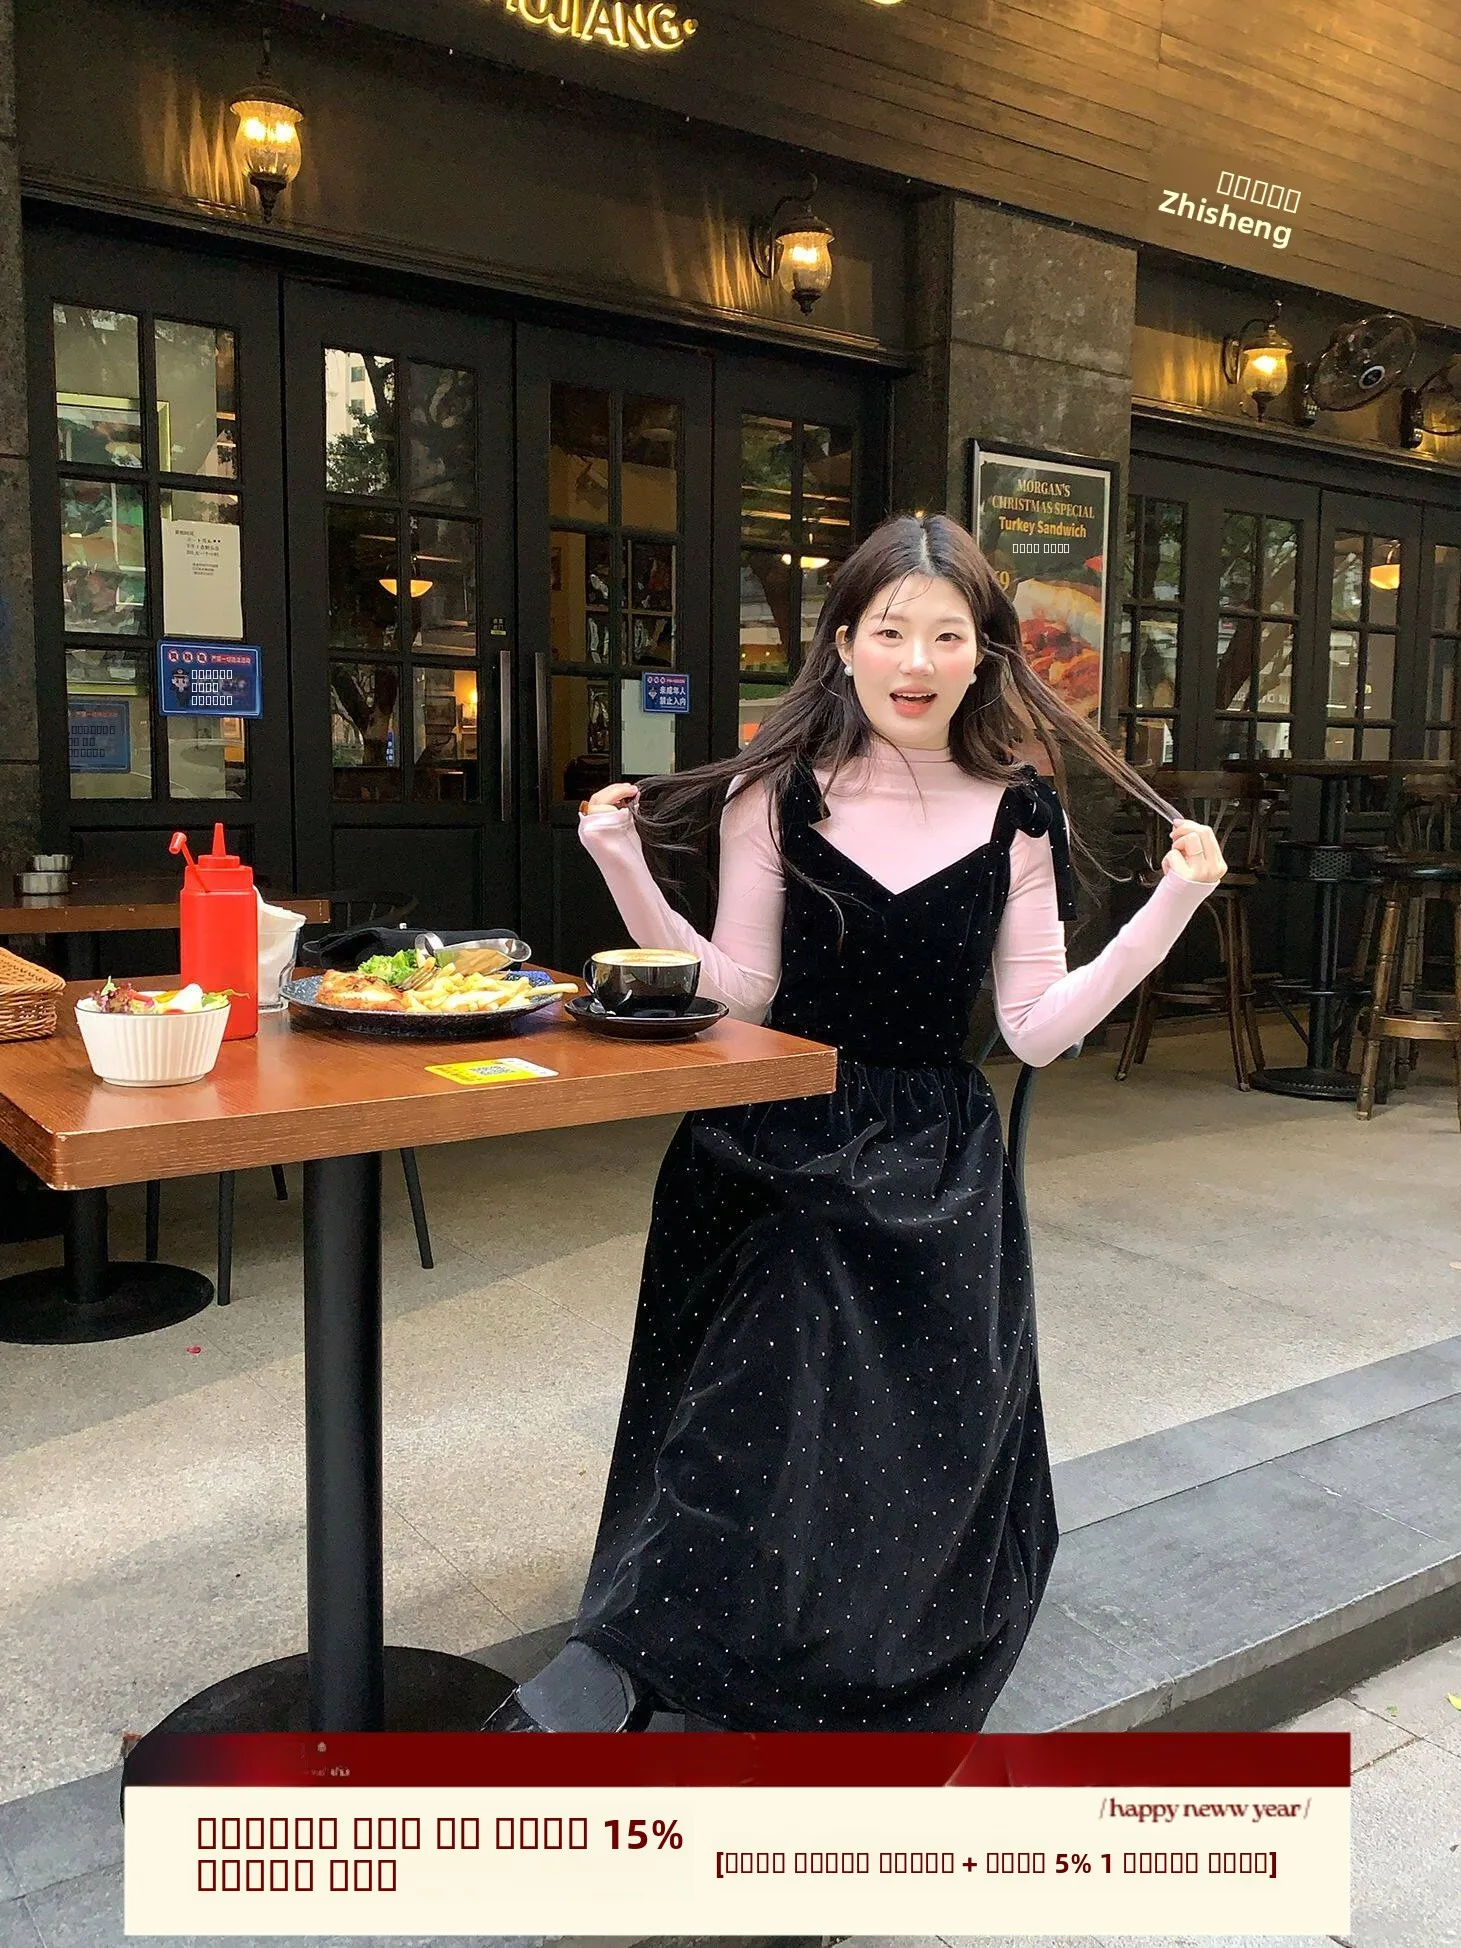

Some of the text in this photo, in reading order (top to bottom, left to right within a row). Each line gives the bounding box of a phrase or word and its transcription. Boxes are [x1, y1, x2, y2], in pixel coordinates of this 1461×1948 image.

[1017, 479, 1071, 497] MORGAN'S
[991, 494, 1095, 519] CHRISTMAS SPECIAL
[999, 516, 1087, 538] Turkey Sandwich
